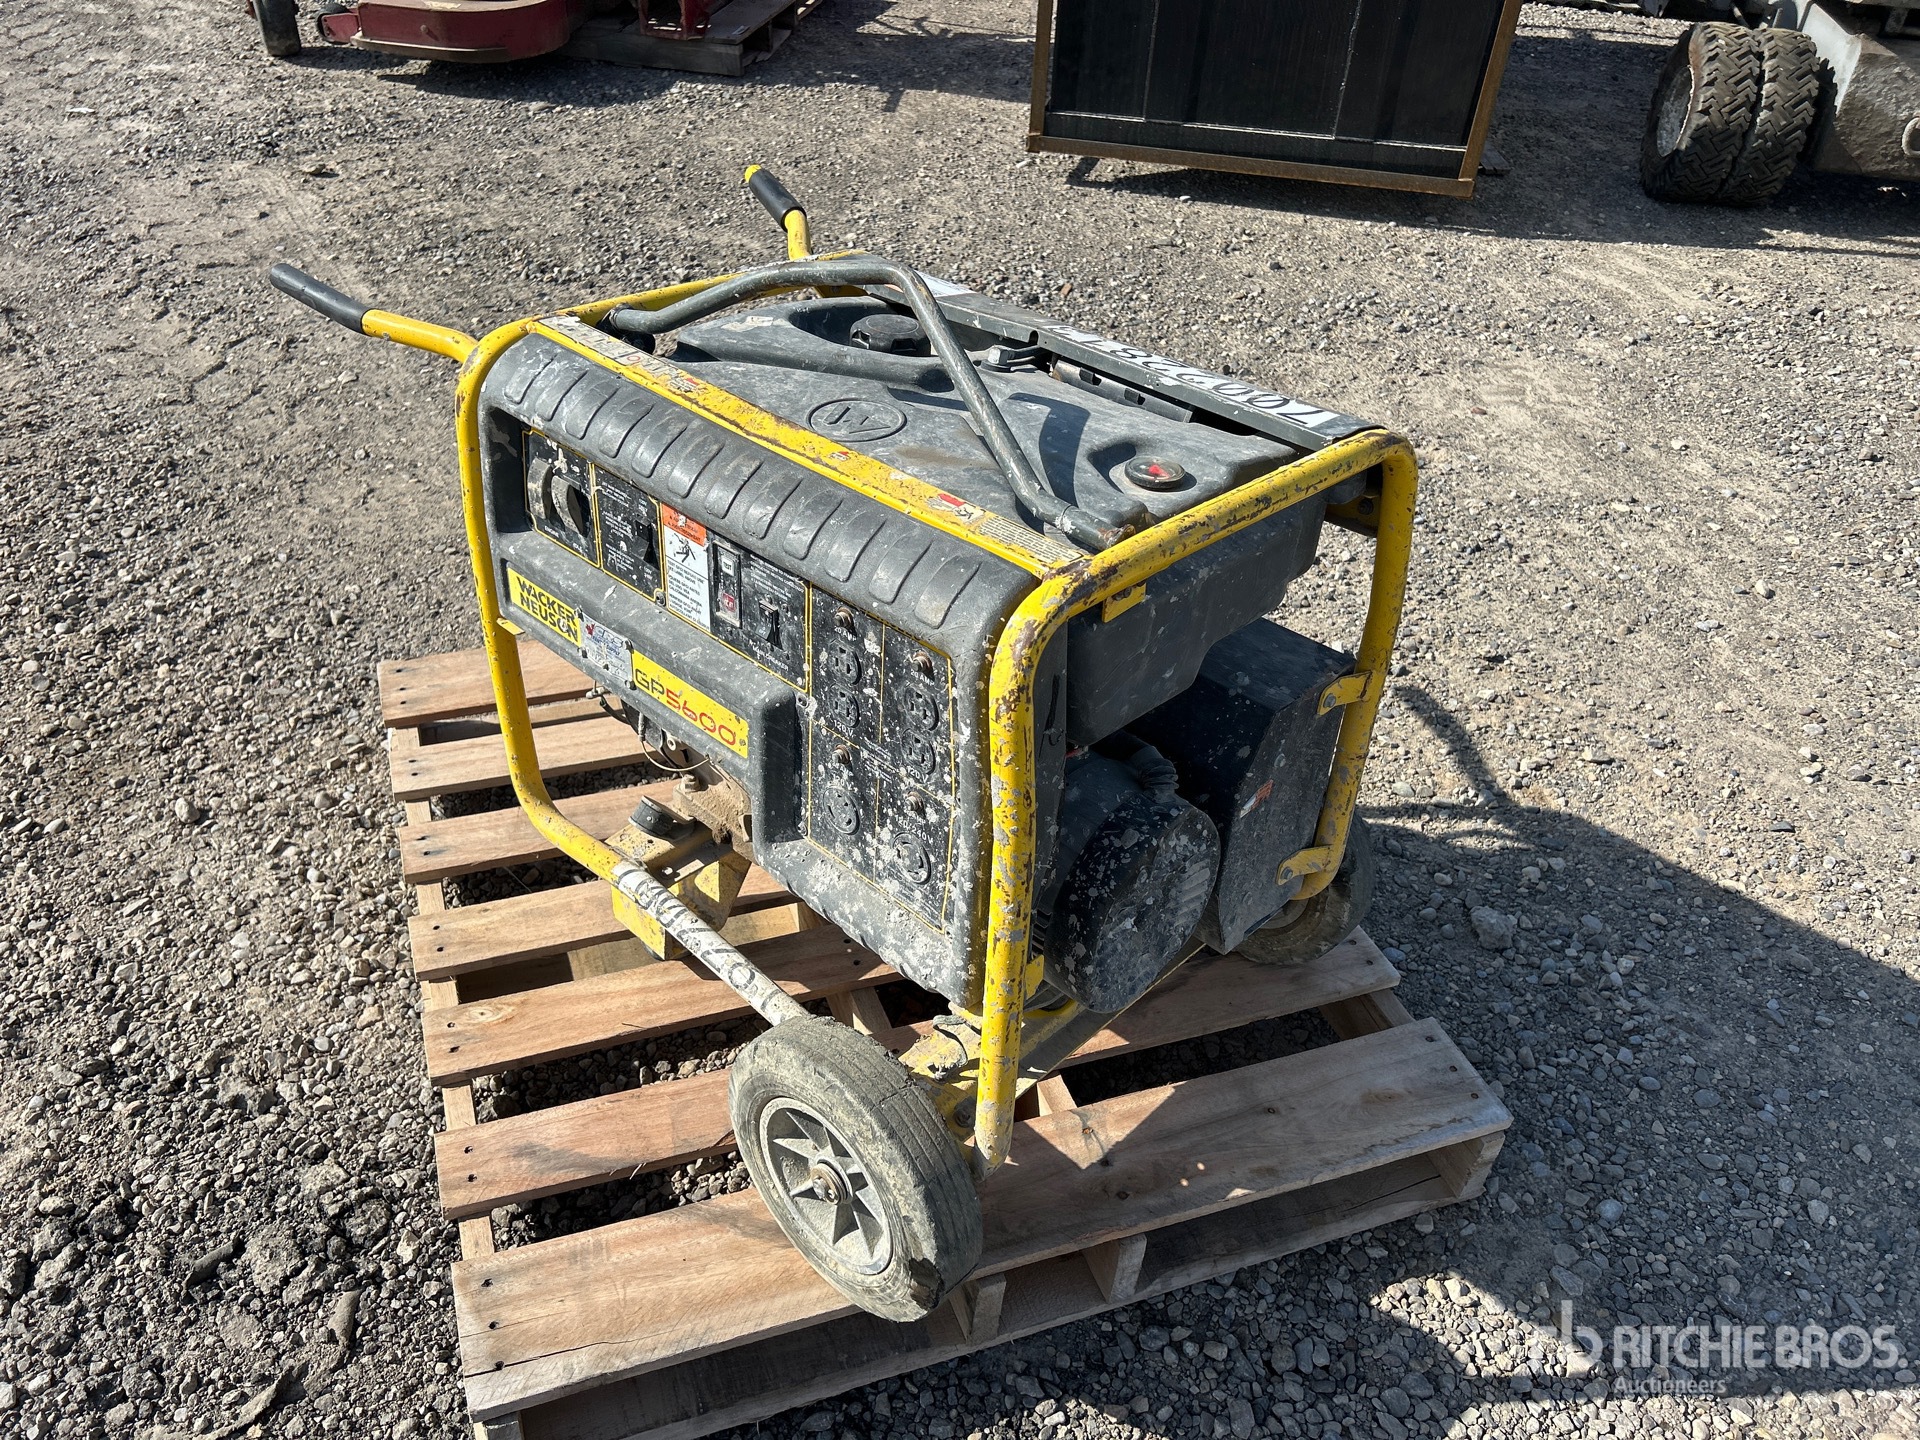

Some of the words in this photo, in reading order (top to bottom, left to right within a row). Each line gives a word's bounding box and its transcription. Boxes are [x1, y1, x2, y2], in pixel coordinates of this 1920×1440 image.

[516, 575, 578, 628] WACKER
[520, 592, 579, 643] NEUSON
[842, 630, 857, 642] AMP
[919, 674, 935, 687] AMP
[635, 668, 737, 747] GP5600
[907, 766, 922, 780] 120
